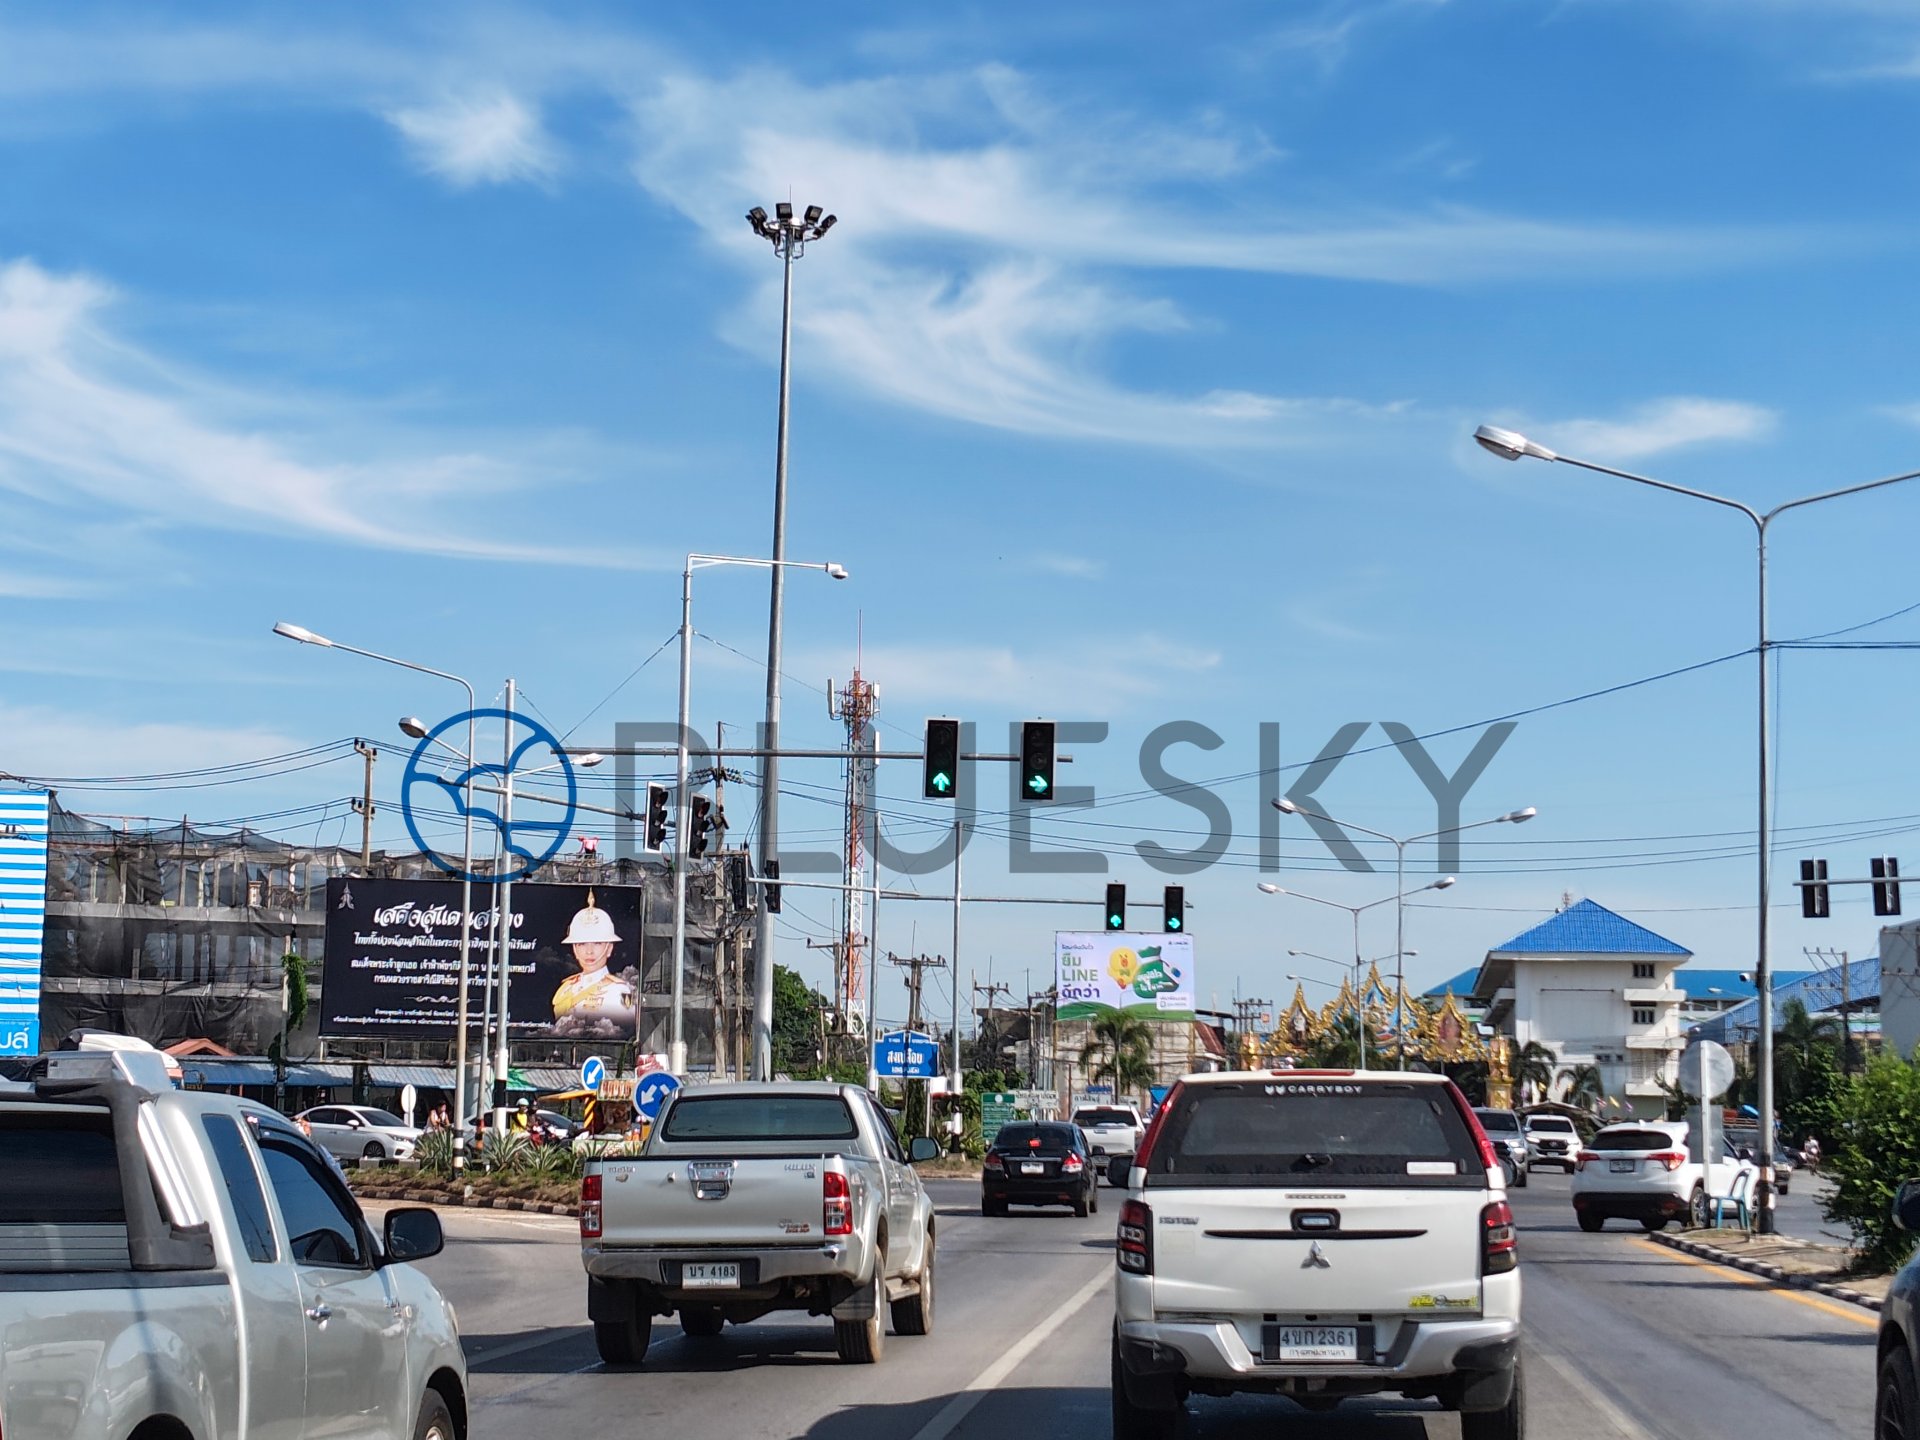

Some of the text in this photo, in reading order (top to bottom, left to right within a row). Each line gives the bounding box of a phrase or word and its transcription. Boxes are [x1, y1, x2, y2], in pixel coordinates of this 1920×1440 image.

[1061, 969, 1099, 982] LINE
[1287, 1085, 1363, 1094] CARRYBOY
[710, 1265, 736, 1278] 4183
[1317, 1329, 1354, 1346] 2361
